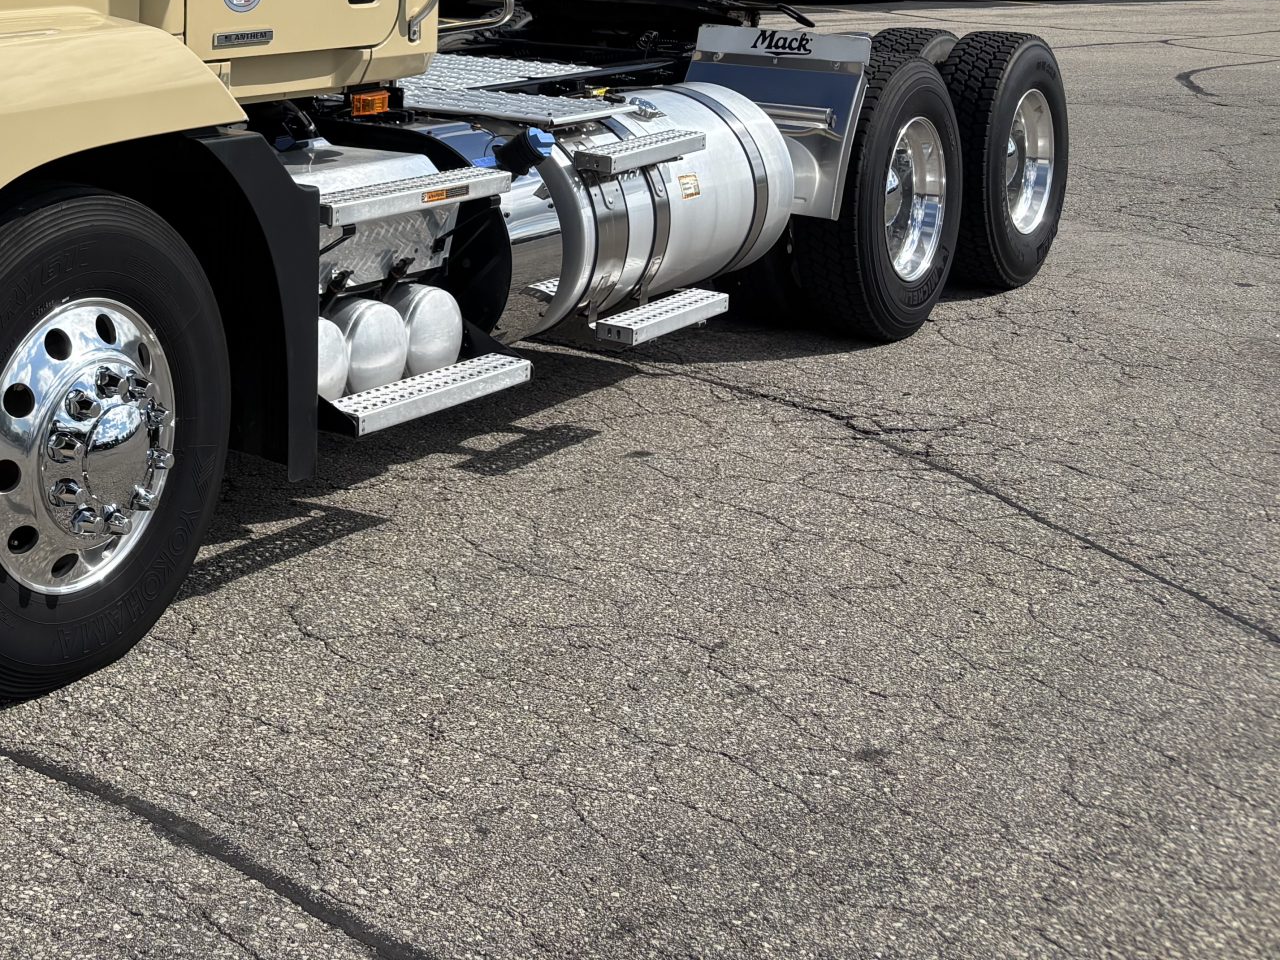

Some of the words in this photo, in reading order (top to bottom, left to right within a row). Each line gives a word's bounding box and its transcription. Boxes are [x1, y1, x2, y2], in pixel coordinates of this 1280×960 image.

[234, 31, 268, 41] ANTHEM
[751, 29, 813, 56] Mack
[53, 509, 201, 660] YOKOHAMA
